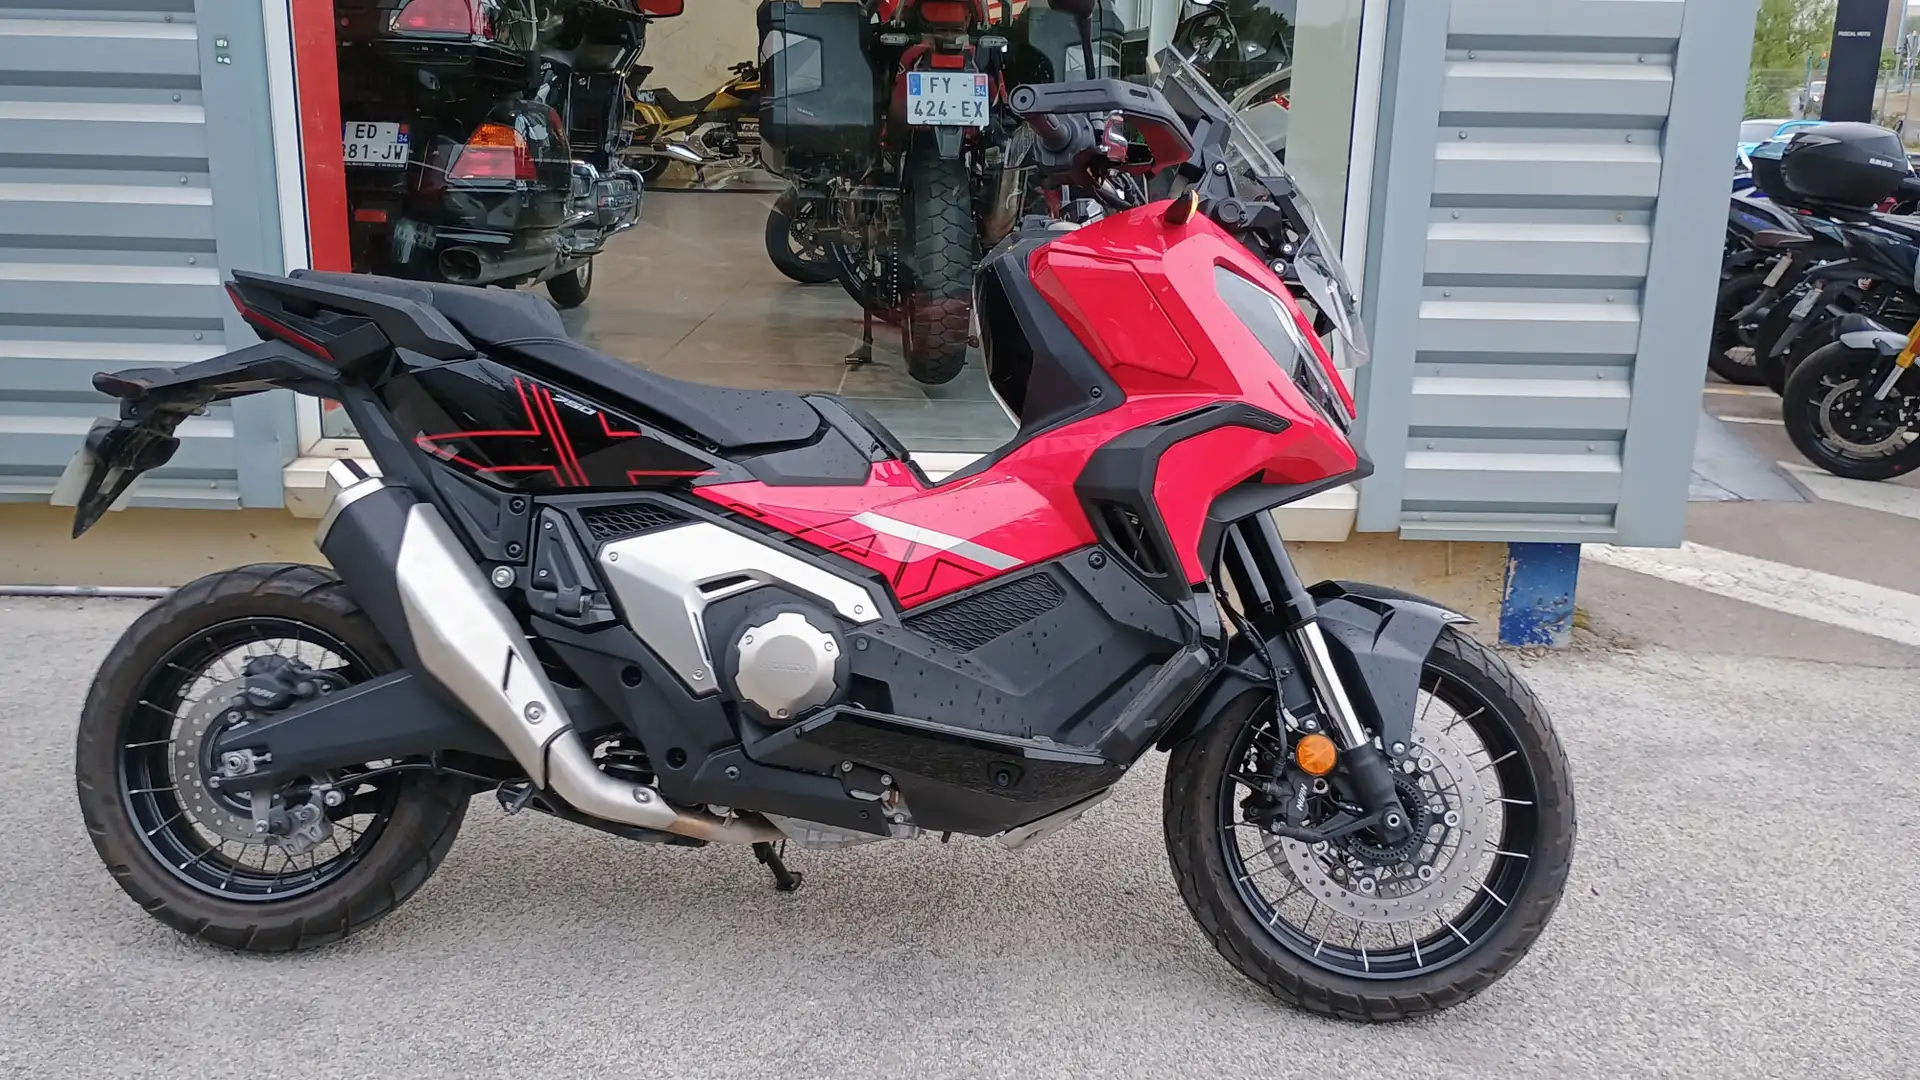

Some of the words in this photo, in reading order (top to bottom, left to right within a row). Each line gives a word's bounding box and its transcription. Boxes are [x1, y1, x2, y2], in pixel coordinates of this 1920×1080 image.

[929, 77, 951, 93] FY
[975, 86, 985, 96] 34
[914, 100, 983, 118] 424-EX
[355, 123, 377, 139] ED
[398, 134, 408, 142] 34
[552, 394, 597, 416] 750
